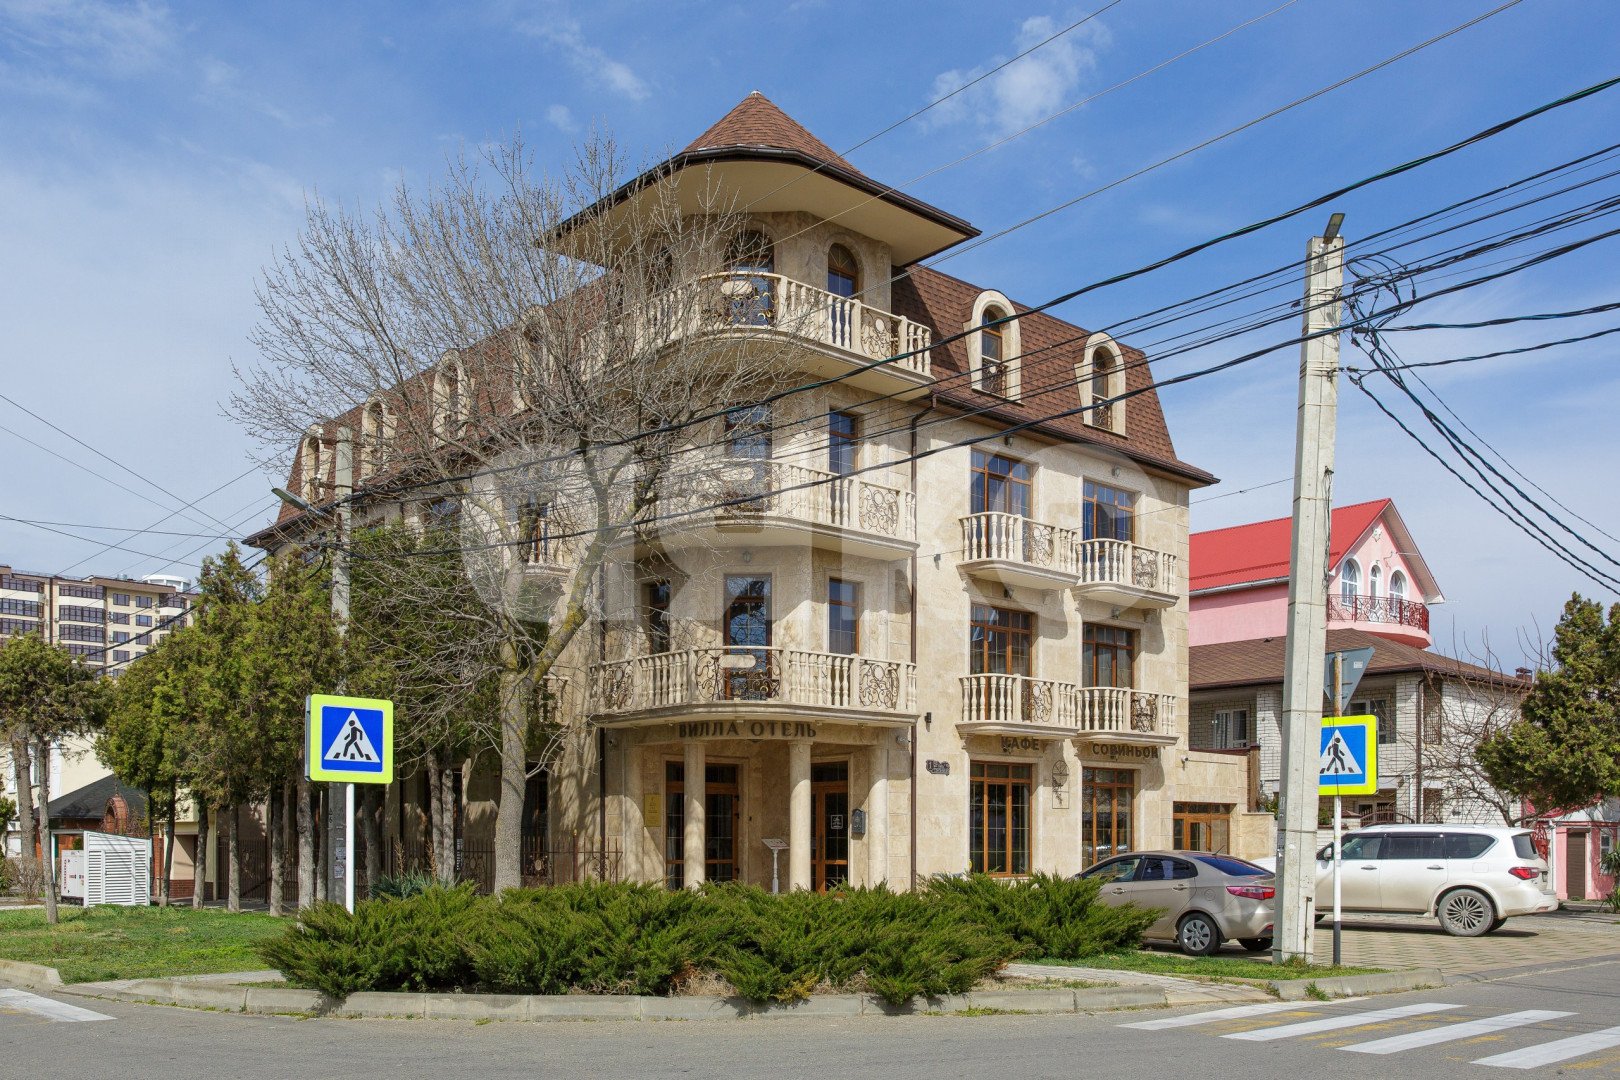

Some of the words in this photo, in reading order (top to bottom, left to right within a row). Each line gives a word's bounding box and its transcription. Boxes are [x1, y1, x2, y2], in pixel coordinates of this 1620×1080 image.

[678, 721, 740, 738] ВИЛЛА
[750, 721, 817, 738] ОТЕЛЬ
[1000, 736, 1040, 751] КАФЕ
[1092, 743, 1159, 759] СОВИНЬОН
